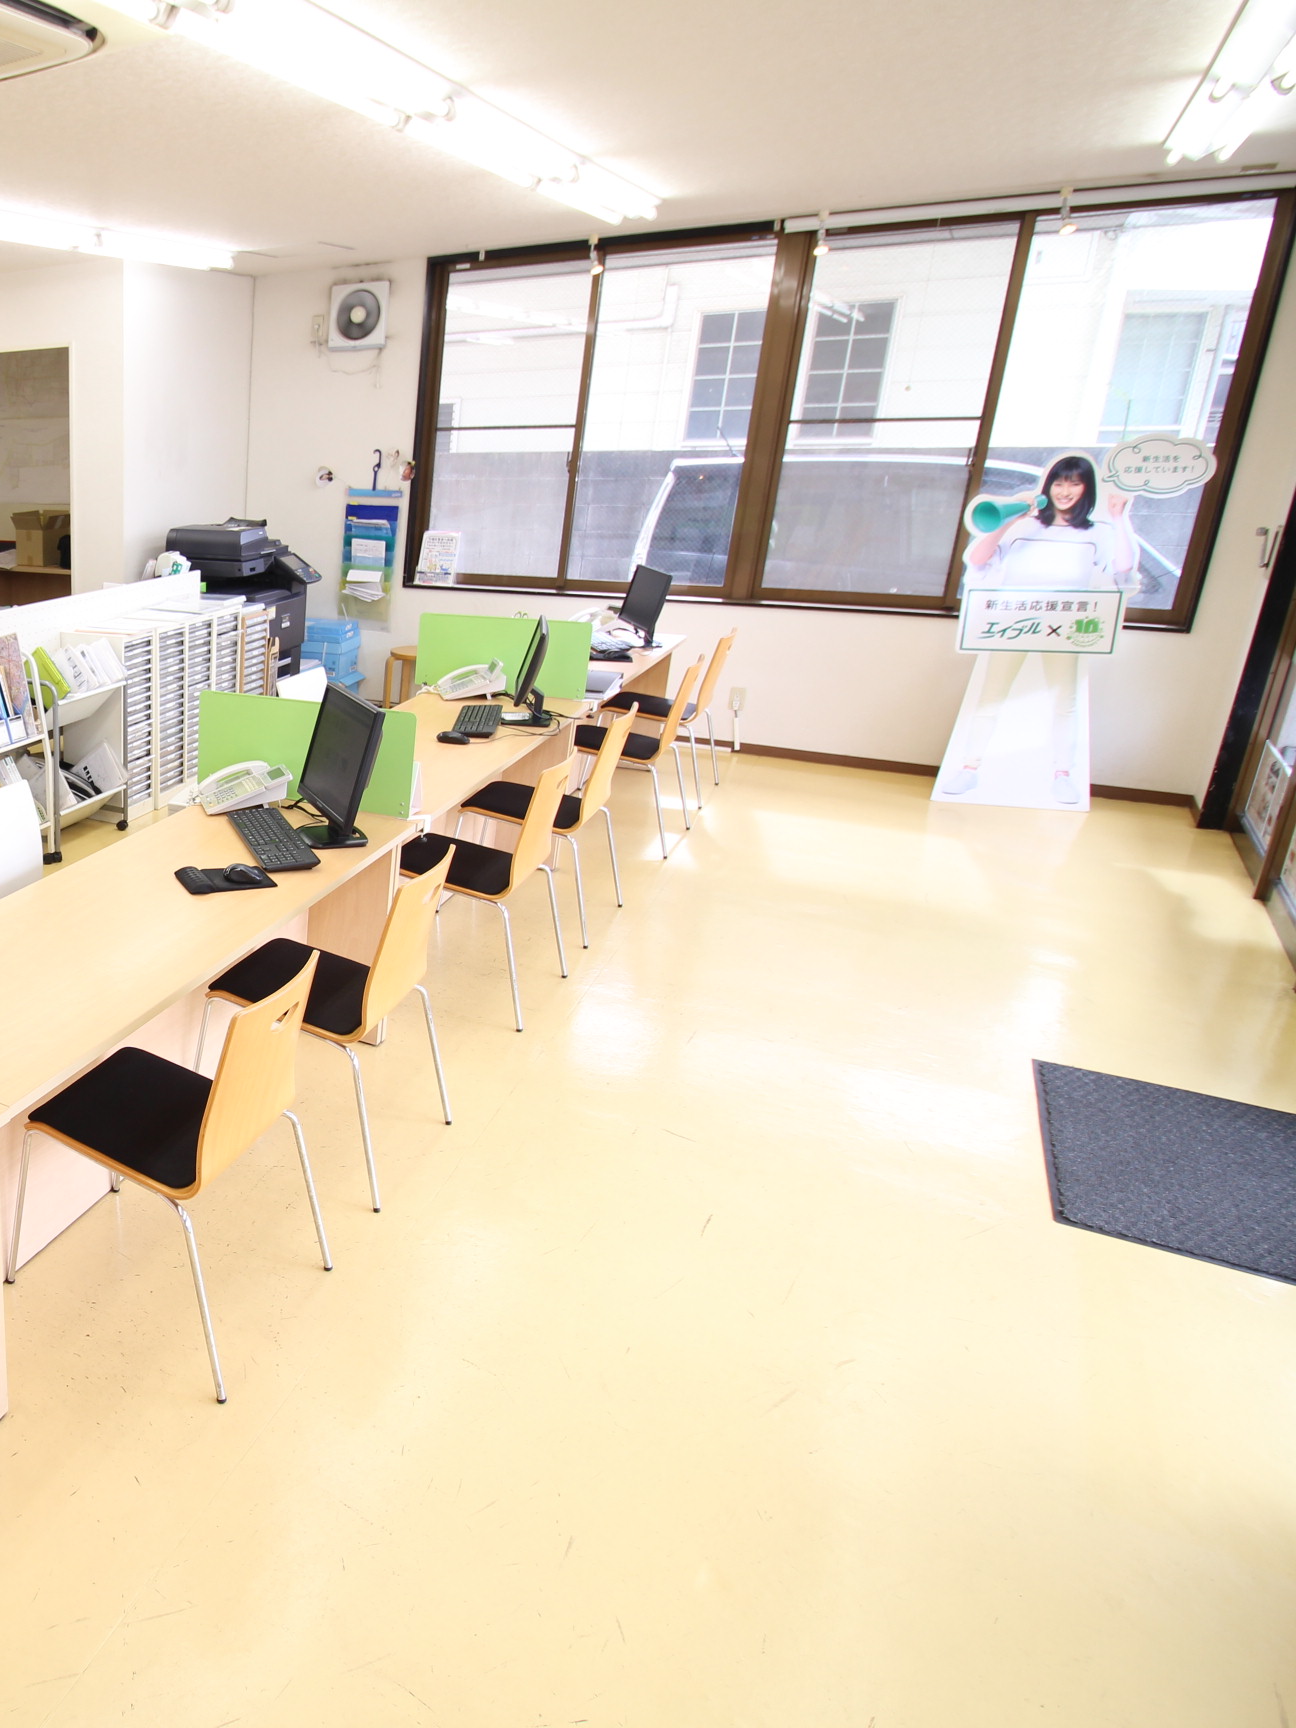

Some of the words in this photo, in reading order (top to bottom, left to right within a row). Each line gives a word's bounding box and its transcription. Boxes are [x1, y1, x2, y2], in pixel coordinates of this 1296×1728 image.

[1142, 454, 1181, 464] 新生活を
[977, 617, 1043, 640] エイブル
